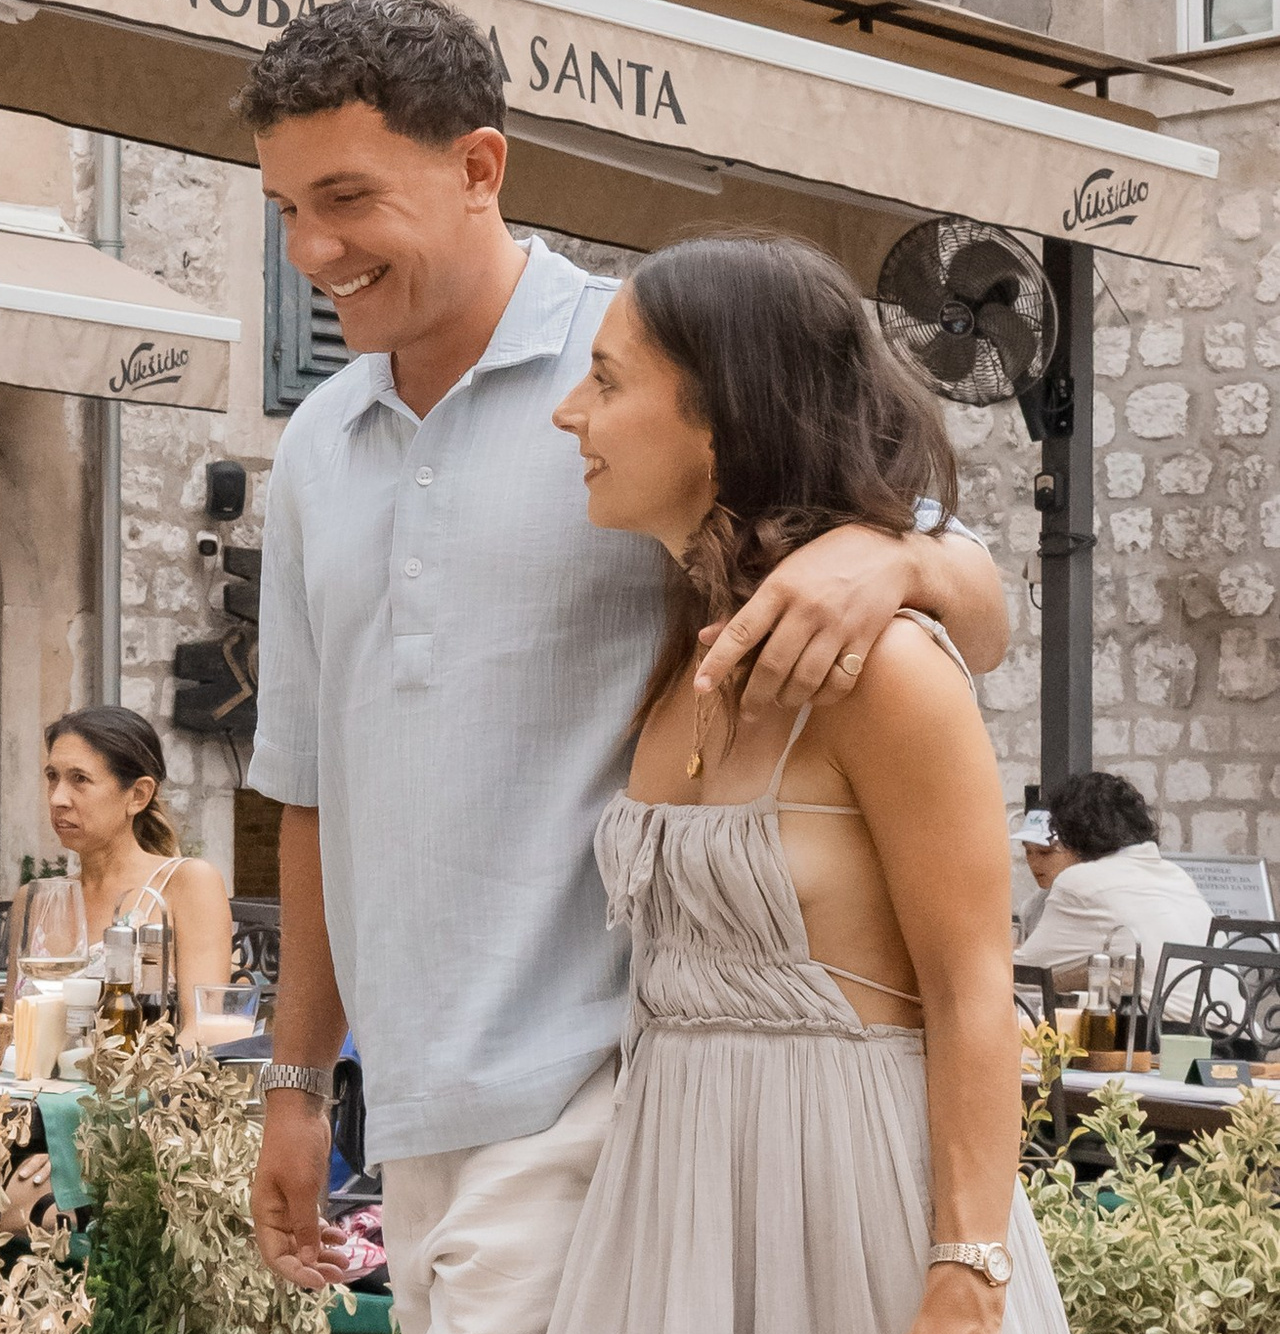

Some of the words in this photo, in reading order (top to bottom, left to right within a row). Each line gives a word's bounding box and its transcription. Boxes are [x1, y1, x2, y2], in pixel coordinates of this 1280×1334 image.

[529, 35, 687, 125] SANTA
[1063, 168, 1149, 232] Nikšićko
[109, 342, 190, 393] Nikšićko
